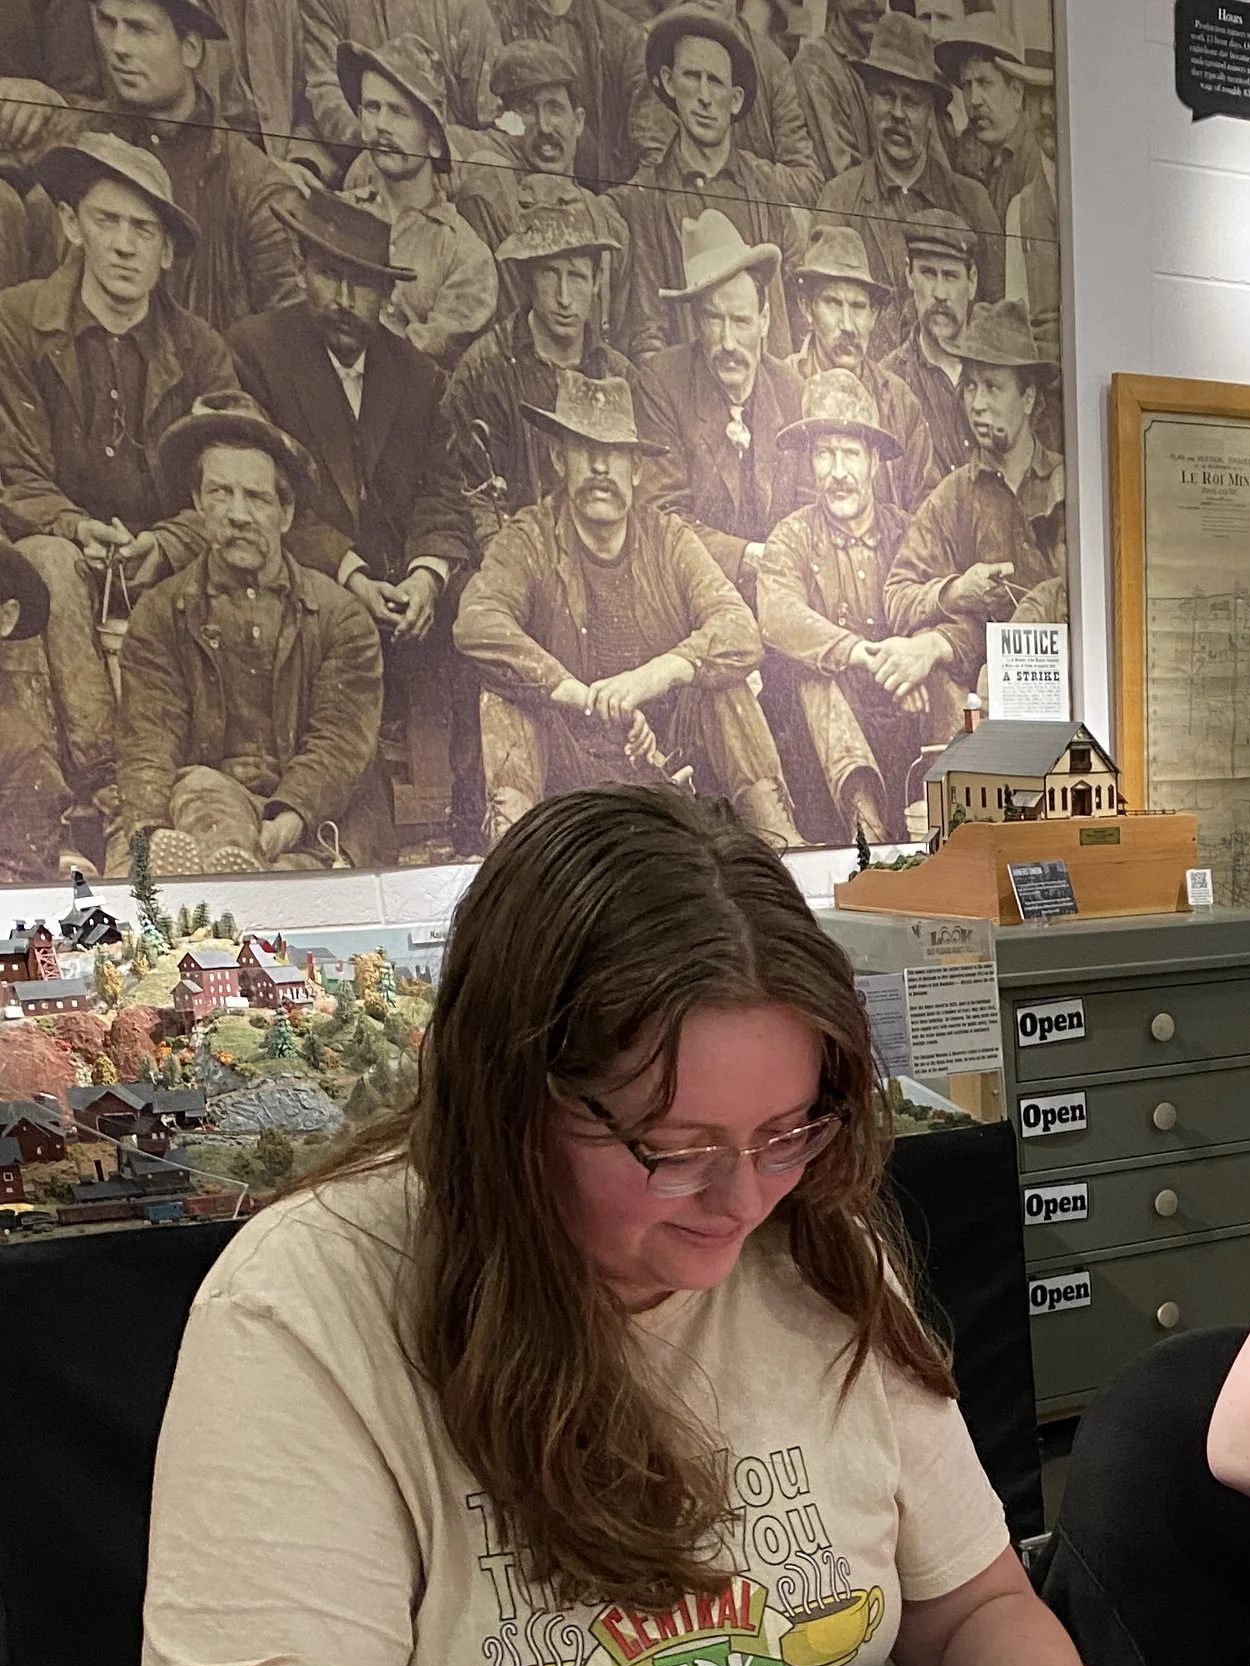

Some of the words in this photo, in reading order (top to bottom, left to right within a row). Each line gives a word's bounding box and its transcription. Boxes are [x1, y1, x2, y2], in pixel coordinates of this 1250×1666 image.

[1218, 8, 1243, 24] Hours
[1202, 471, 1224, 485] ROI
[1001, 629, 1059, 655] NOTICE
[1002, 671, 1011, 681] A
[1016, 670, 1060, 681] STRIKE
[930, 925, 973, 946] LOOK
[1020, 1011, 1083, 1041] Open
[1023, 1103, 1085, 1132] Open
[1026, 1193, 1086, 1221] Open
[1030, 1282, 1090, 1310] Open
